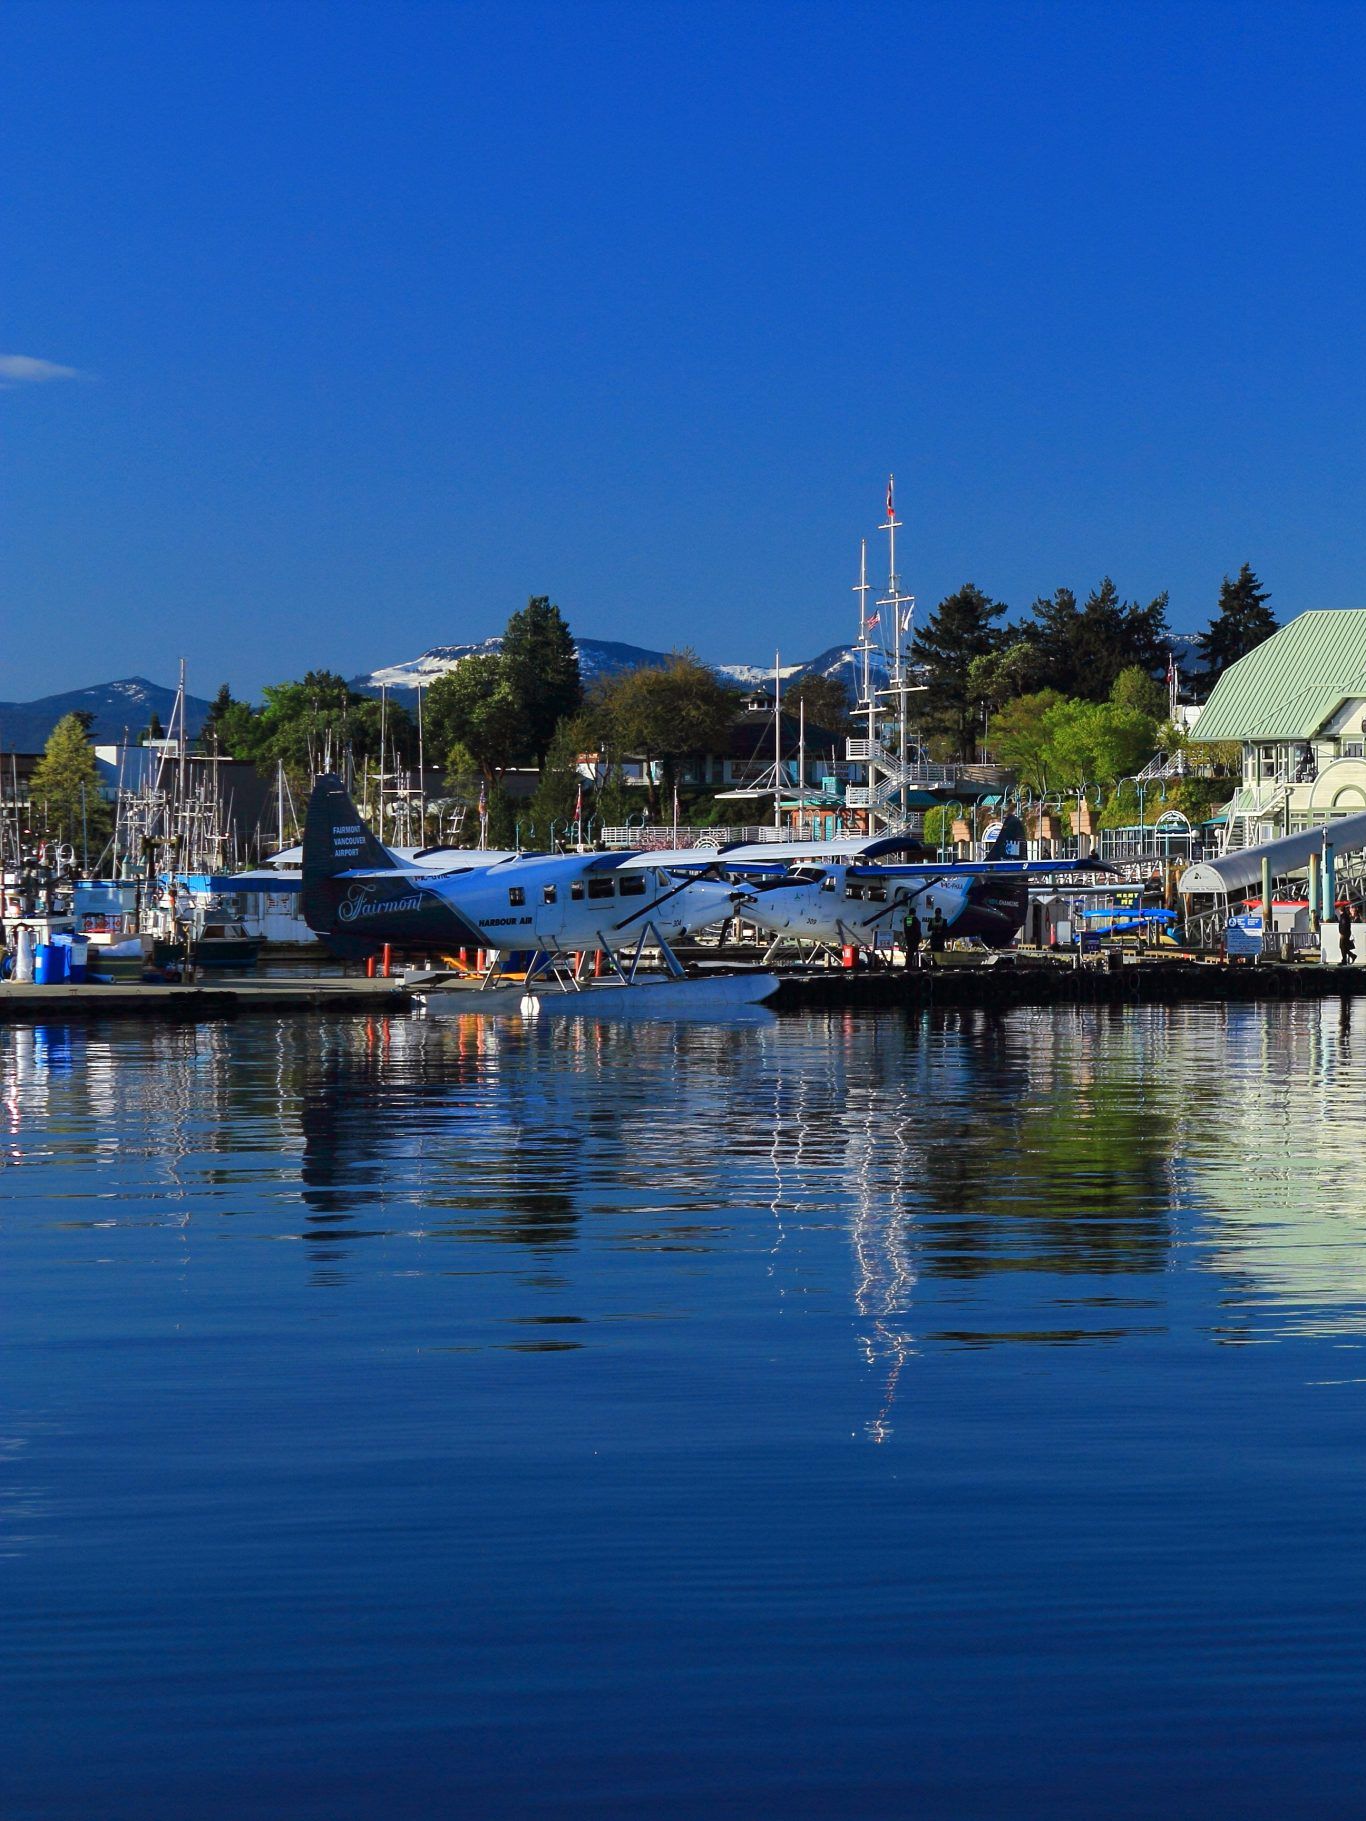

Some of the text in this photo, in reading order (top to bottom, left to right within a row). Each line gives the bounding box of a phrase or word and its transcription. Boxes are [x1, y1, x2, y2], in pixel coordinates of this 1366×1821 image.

[333, 826, 360, 834] FAIRMONT
[334, 837, 366, 845] VANCOUVER
[335, 849, 359, 857] AIRPORT
[338, 884, 425, 921] Fairmont
[479, 916, 533, 927] HARBOUR AIR
